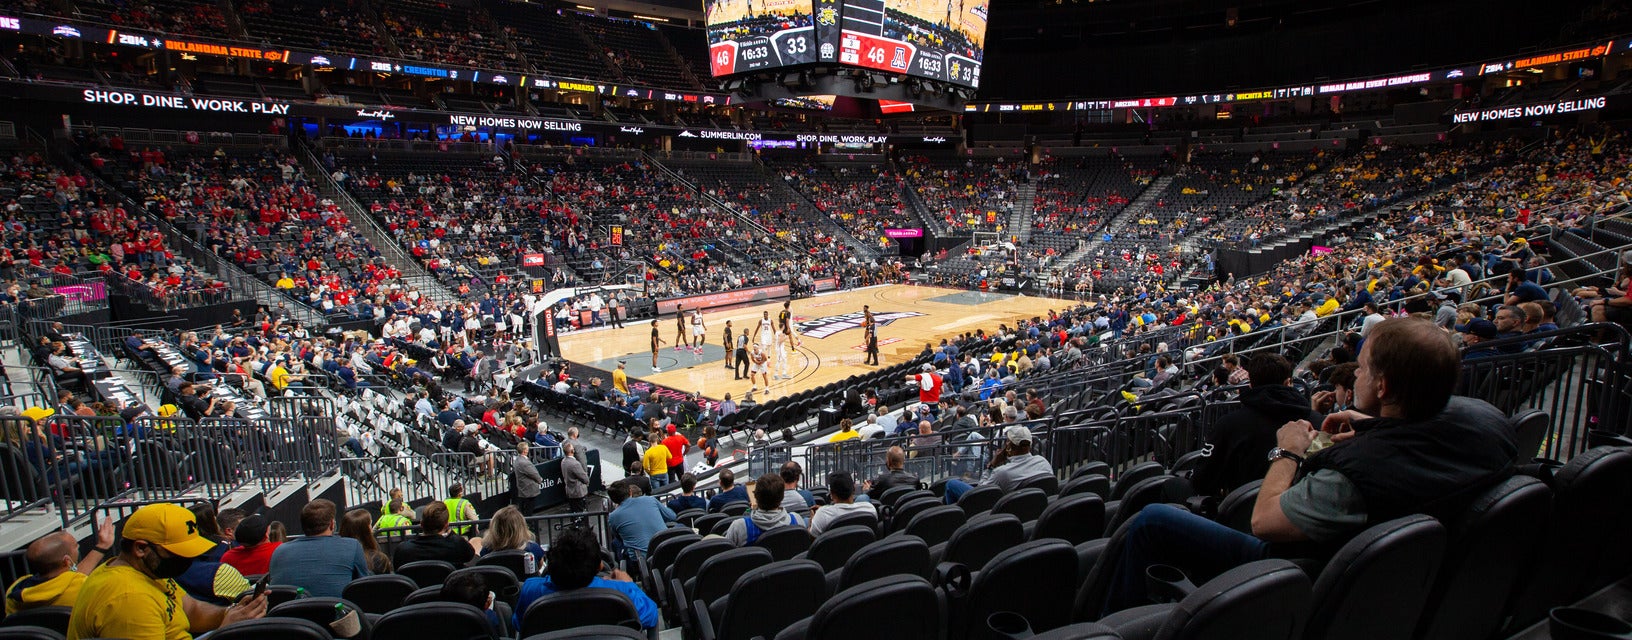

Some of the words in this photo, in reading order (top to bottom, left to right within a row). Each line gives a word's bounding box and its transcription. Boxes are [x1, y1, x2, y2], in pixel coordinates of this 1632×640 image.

[118, 34, 148, 47] 2014
[165, 40, 229, 56] OKLAHOMA
[229, 47, 262, 59] STATE
[741, 46, 768, 60] 16:33
[786, 36, 807, 54] 33
[717, 50, 729, 66] 46
[867, 46, 885, 64] 46
[1515, 53, 1561, 68] OKLAHOMA
[1563, 48, 1590, 61] STATE
[371, 61, 392, 72] 2015
[403, 65, 448, 77] CREIGHTON
[918, 57, 941, 73] 16:33
[962, 67, 971, 81] 33
[559, 82, 595, 92] VALPARAISO
[1319, 83, 1344, 93] ROMAN
[1346, 81, 1365, 90] MAIN
[1366, 79, 1387, 88] EVENT
[1388, 73, 1430, 85] CHAMPIONS
[83, 89, 138, 105] SHOP.
[142, 95, 188, 109] DINE.
[192, 98, 248, 112] WORK.
[252, 102, 290, 115] PLAY
[1236, 92, 1262, 100] WICHITA
[1453, 112, 1480, 123] NEW
[1481, 107, 1522, 121] HOMES
[1525, 103, 1556, 117] NOW
[1557, 97, 1606, 113] SELLING
[450, 115, 476, 126] NEW
[479, 116, 515, 128] HOMES
[518, 119, 541, 129] NOW
[544, 120, 582, 132] SELLING
[700, 130, 762, 141] SUMMERLIN.COM
[868, 136, 888, 144] PLAY
[545, 310, 554, 336] roman
